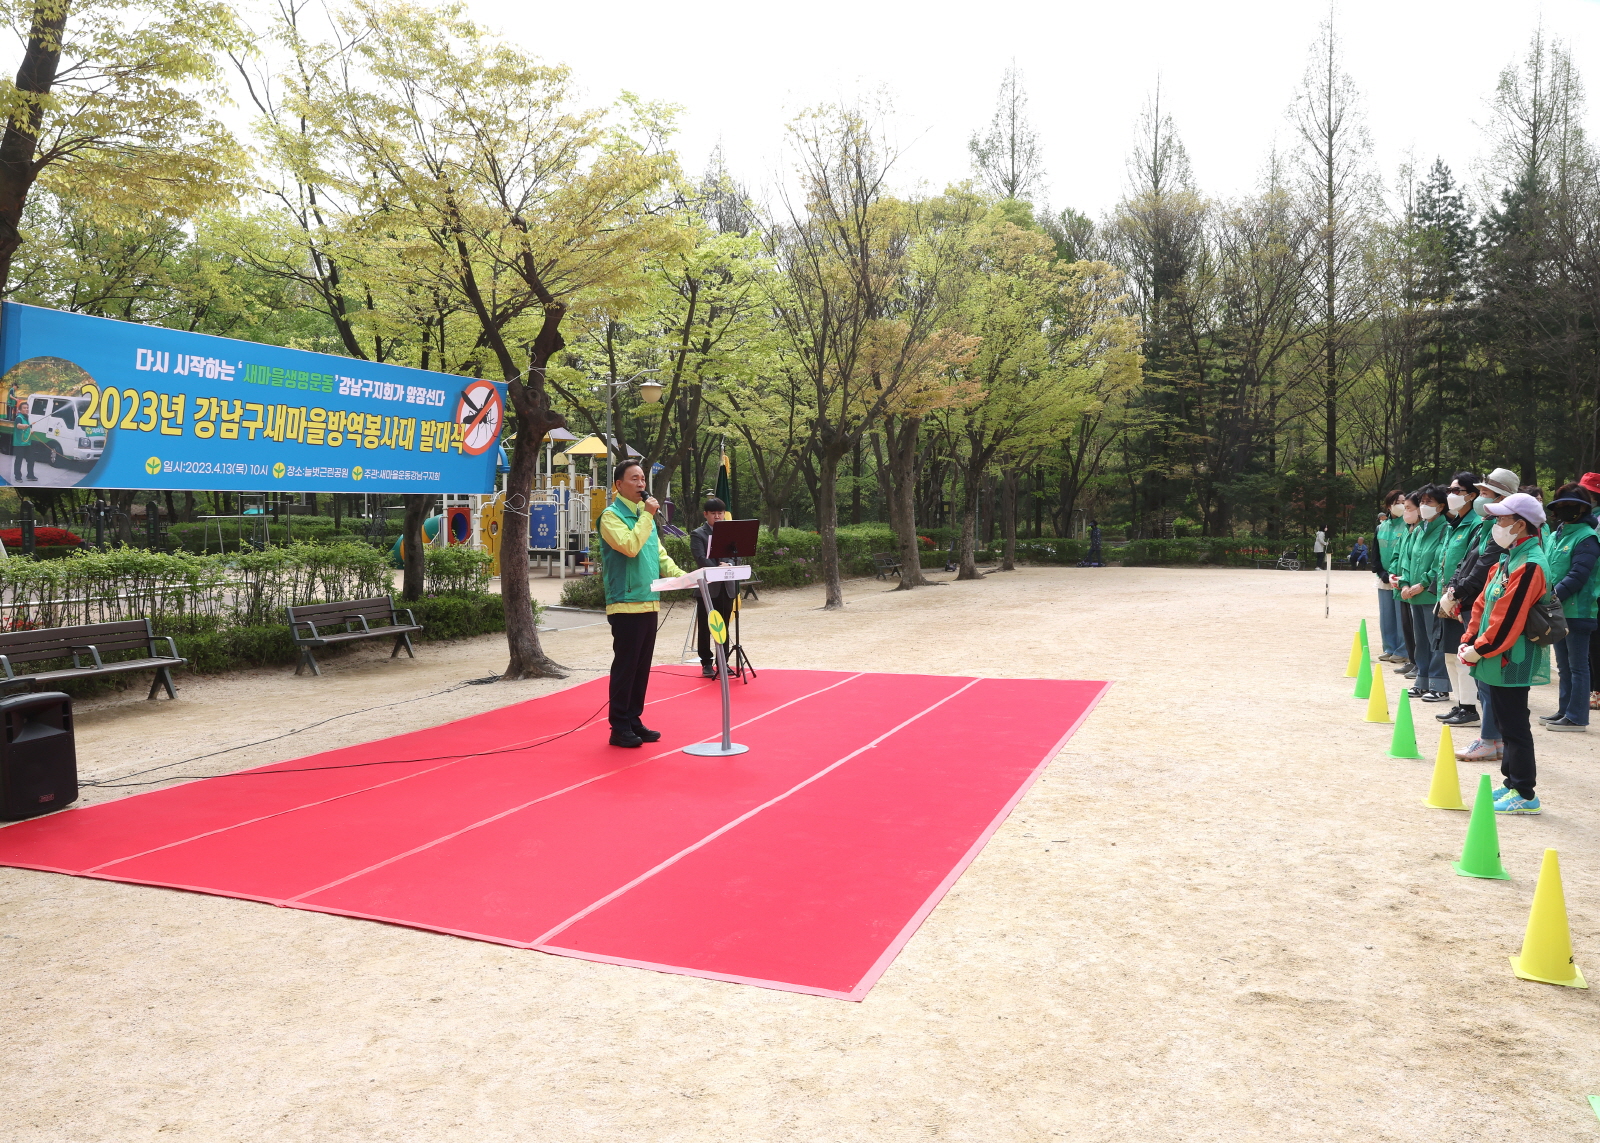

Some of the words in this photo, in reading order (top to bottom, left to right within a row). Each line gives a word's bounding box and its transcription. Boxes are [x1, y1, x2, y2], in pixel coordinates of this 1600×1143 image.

[135, 347, 170, 374] 다시
[173, 353, 236, 382] 시작하는
[338, 376, 405, 402] 강남구지회가
[405, 385, 446, 407] 앞장선다
[78, 383, 186, 436] 2023년
[193, 396, 417, 451] 강남구새마을방역봉사대
[419, 419, 466, 455] 발대식
[163, 460, 248, 475] 일시:2023.4.13(목)
[249, 464, 269, 476] 10시
[286, 465, 349, 478] 장소:늘벗근린공원
[363, 468, 441, 481] 주관:새마을운동강남구지회
